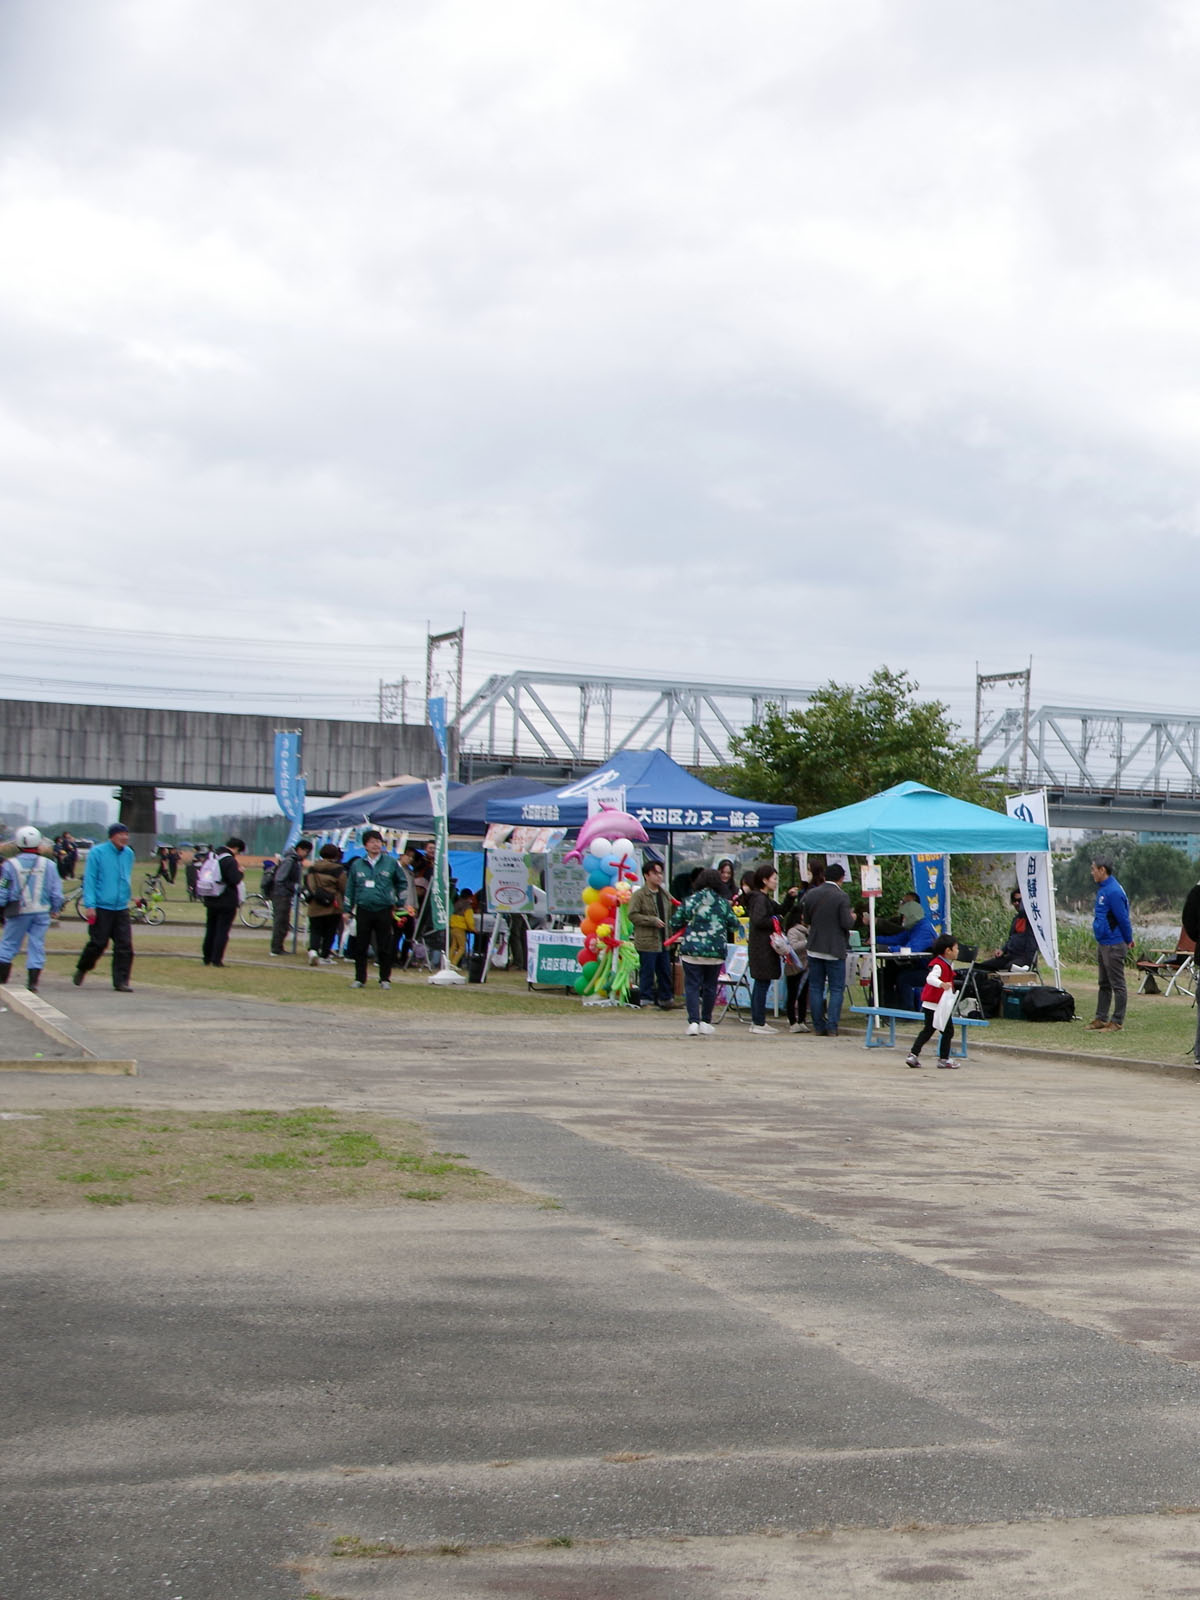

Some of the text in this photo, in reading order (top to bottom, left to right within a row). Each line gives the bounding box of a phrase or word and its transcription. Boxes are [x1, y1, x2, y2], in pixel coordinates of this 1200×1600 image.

[635, 807, 760, 828] 大田区カヌー協会
